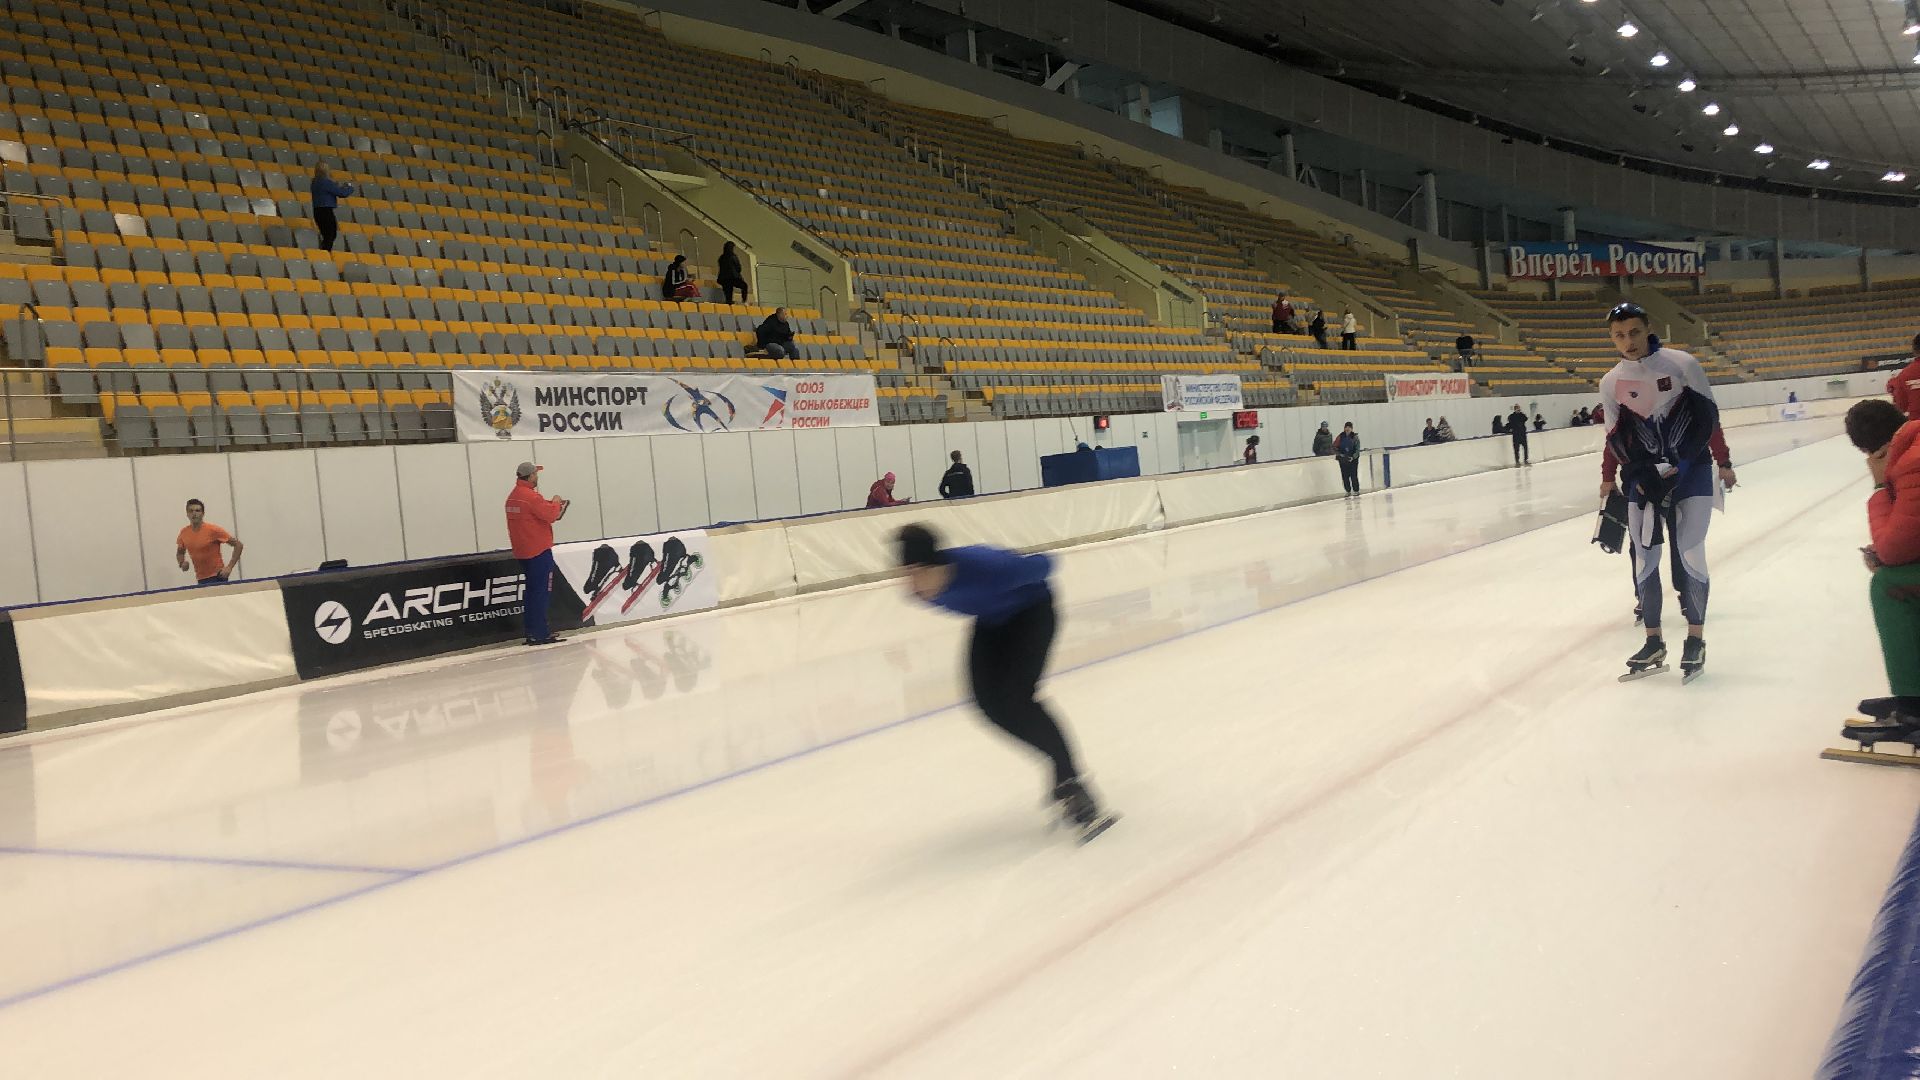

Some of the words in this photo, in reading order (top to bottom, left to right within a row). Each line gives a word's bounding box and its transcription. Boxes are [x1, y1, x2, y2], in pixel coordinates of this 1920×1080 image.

[1608, 243, 1705, 275] Россия!
[535, 386, 648, 407] МИНСПОРТ
[795, 382, 825, 394] СОЮЗ
[792, 398, 870, 412] КОНЬКОБЕЖЦЕВ
[538, 411, 623, 433] РОССИИ
[791, 416, 830, 429] РОССИИ
[363, 617, 454, 640] SPEEDSKATING
[459, 605, 526, 624] TECHNOLO
